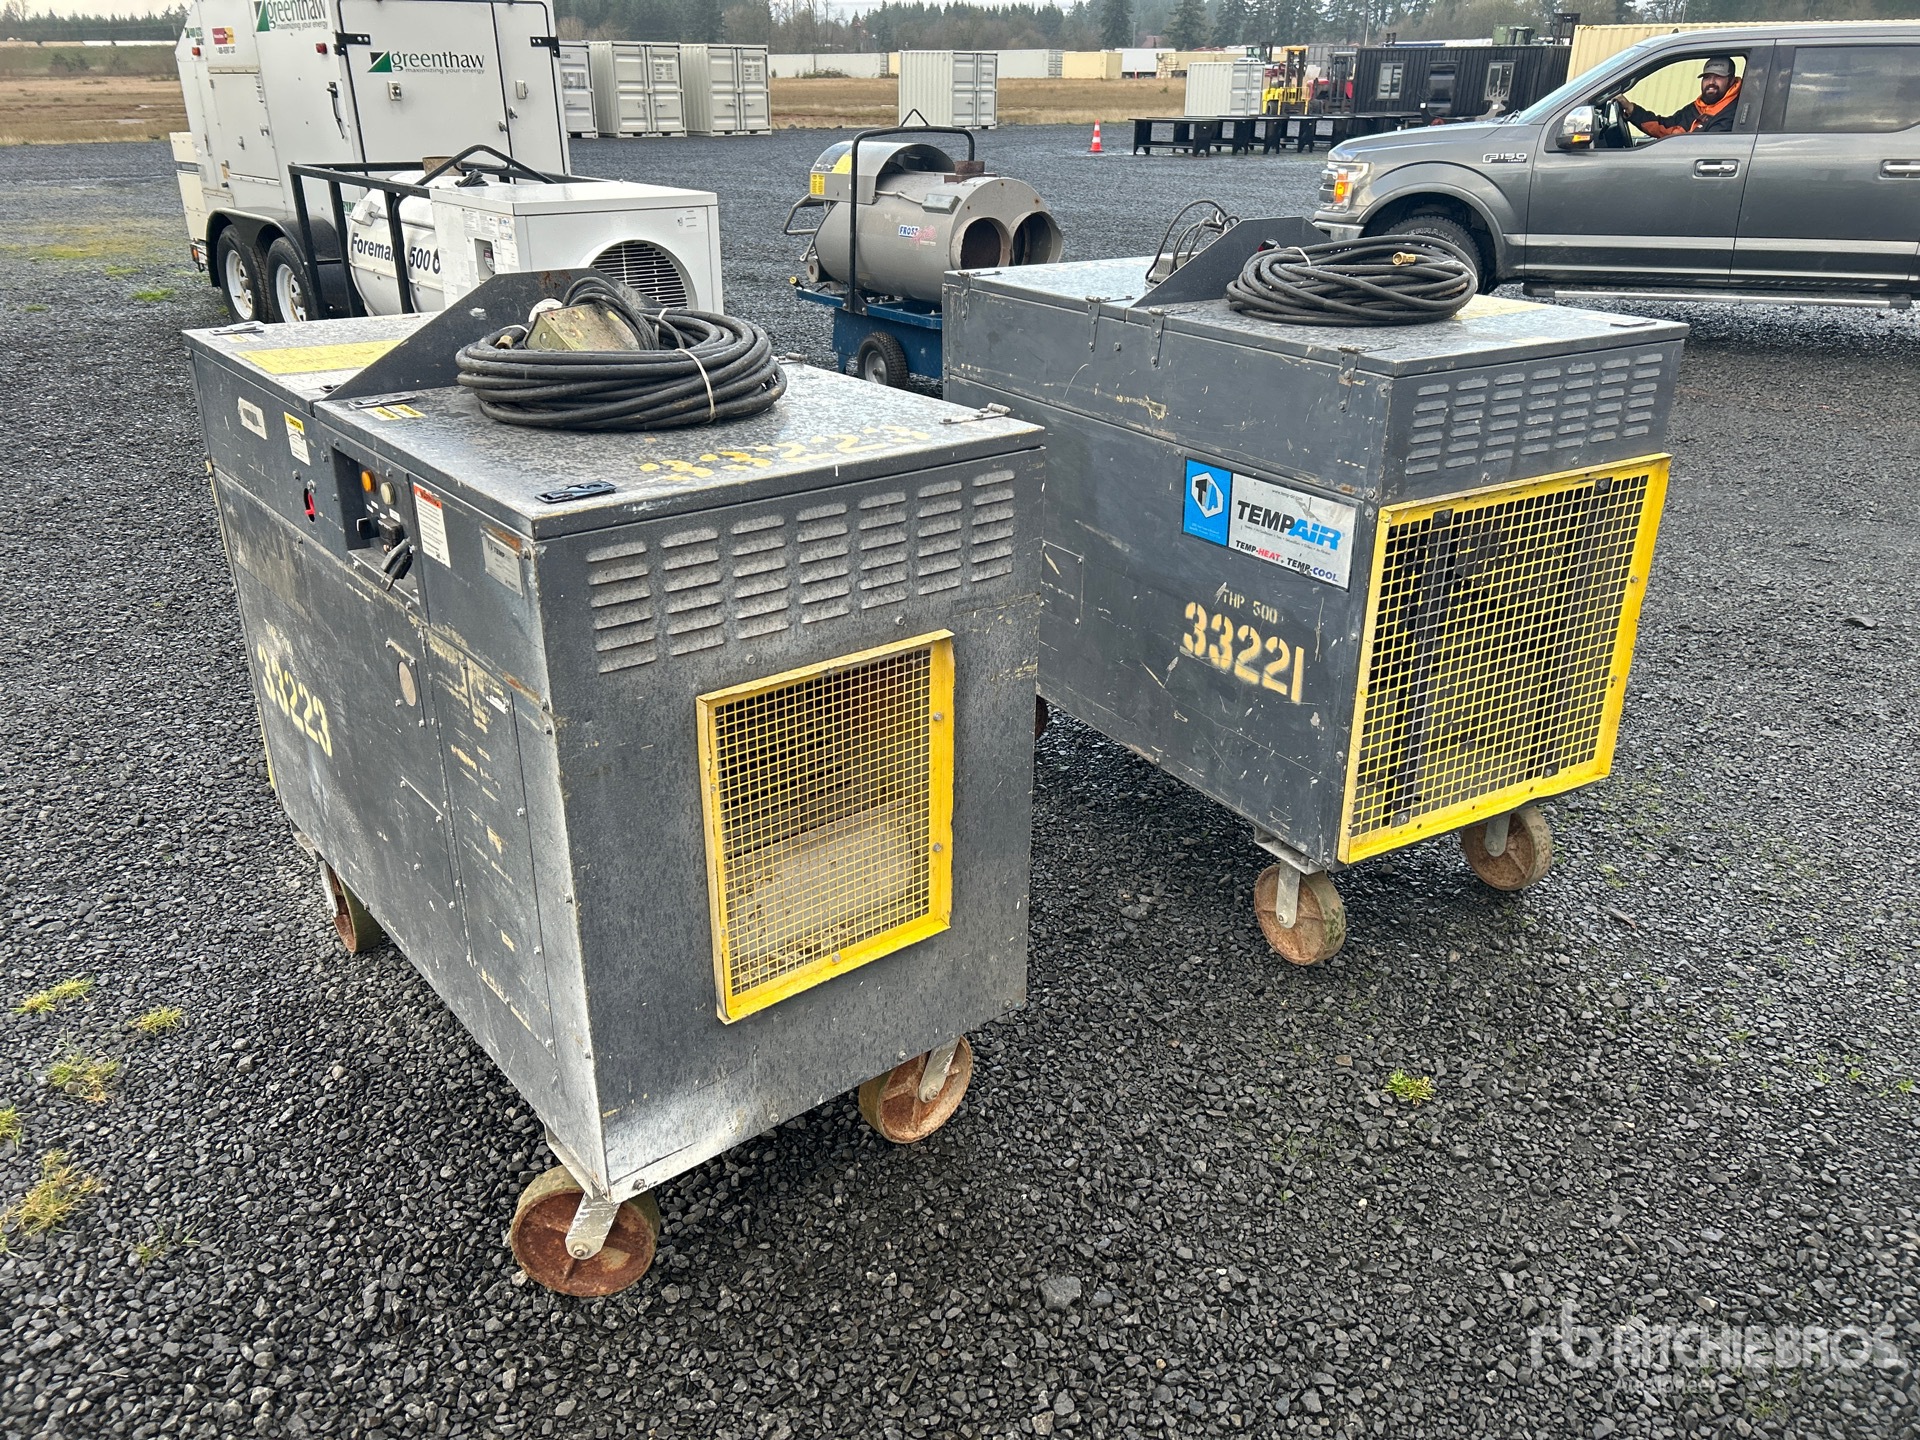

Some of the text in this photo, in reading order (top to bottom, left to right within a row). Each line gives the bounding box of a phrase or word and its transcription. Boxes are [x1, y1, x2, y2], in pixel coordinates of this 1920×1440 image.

[266, 0, 327, 29] greenthaw
[391, 51, 485, 72] greenthaw
[405, 67, 444, 75] maximizing
[899, 226, 919, 236] FROST
[408, 246, 431, 271] 500
[639, 424, 931, 482] 33223
[1252, 600, 1279, 625] 500
[1183, 601, 1305, 706] 33221
[257, 642, 333, 758] 33223
